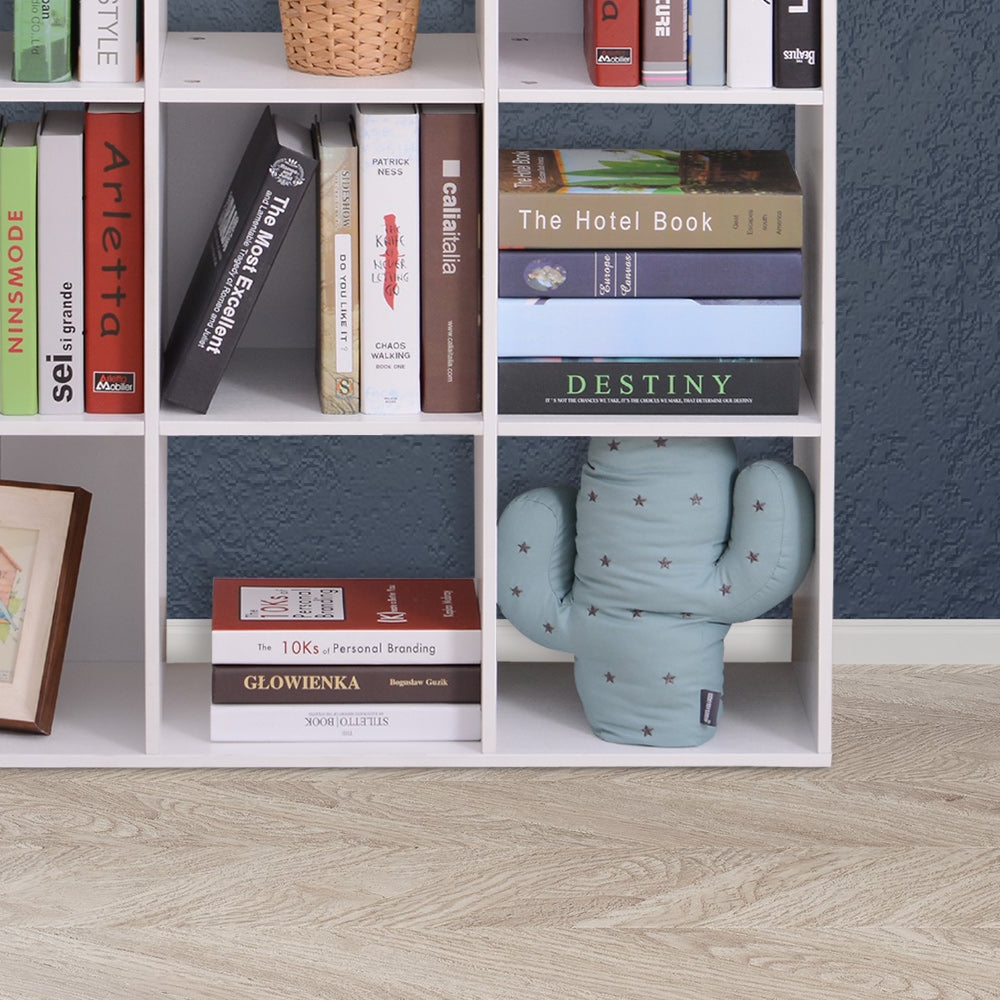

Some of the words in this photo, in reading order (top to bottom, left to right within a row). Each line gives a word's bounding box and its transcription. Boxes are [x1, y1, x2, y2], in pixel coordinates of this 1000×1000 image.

[372, 158, 410, 166] PATRICK
[377, 168, 403, 176] NESS
[262, 190, 273, 205] and
[341, 170, 352, 228] SIDESHOW
[264, 196, 290, 226] The
[519, 209, 562, 230] The
[575, 210, 640, 231] Hotel
[654, 211, 713, 232] Book
[243, 205, 268, 246] Lamentable
[442, 182, 462, 275] caliaitalia
[101, 141, 132, 337] Arletta
[242, 229, 274, 273] Most
[228, 248, 249, 278] Tragedy
[339, 254, 347, 270] DO
[619, 253, 632, 296] Canvas
[8, 211, 24, 353] NINSMODE
[226, 277, 233, 287] of
[339, 274, 347, 299] YOU
[599, 254, 612, 296] Europe
[60, 282, 76, 334] grande
[213, 286, 231, 313] Romeo
[206, 275, 254, 354] Excellent
[207, 313, 217, 328] and
[339, 302, 347, 327] LIKE
[63, 338, 73, 351] si
[339, 330, 347, 342] IT
[375, 342, 406, 350] CHAOS
[371, 351, 411, 360] WALKING
[46, 355, 73, 403] sei
[567, 374, 732, 395] DESTINY
[258, 643, 271, 652] The
[282, 640, 319, 654] 10Ks
[323, 647, 330, 655] of
[333, 643, 382, 654] Personal
[388, 643, 436, 655] Branding
[243, 675, 360, 690] GŁOWIENKA
[304, 716, 335, 727] BOOK
